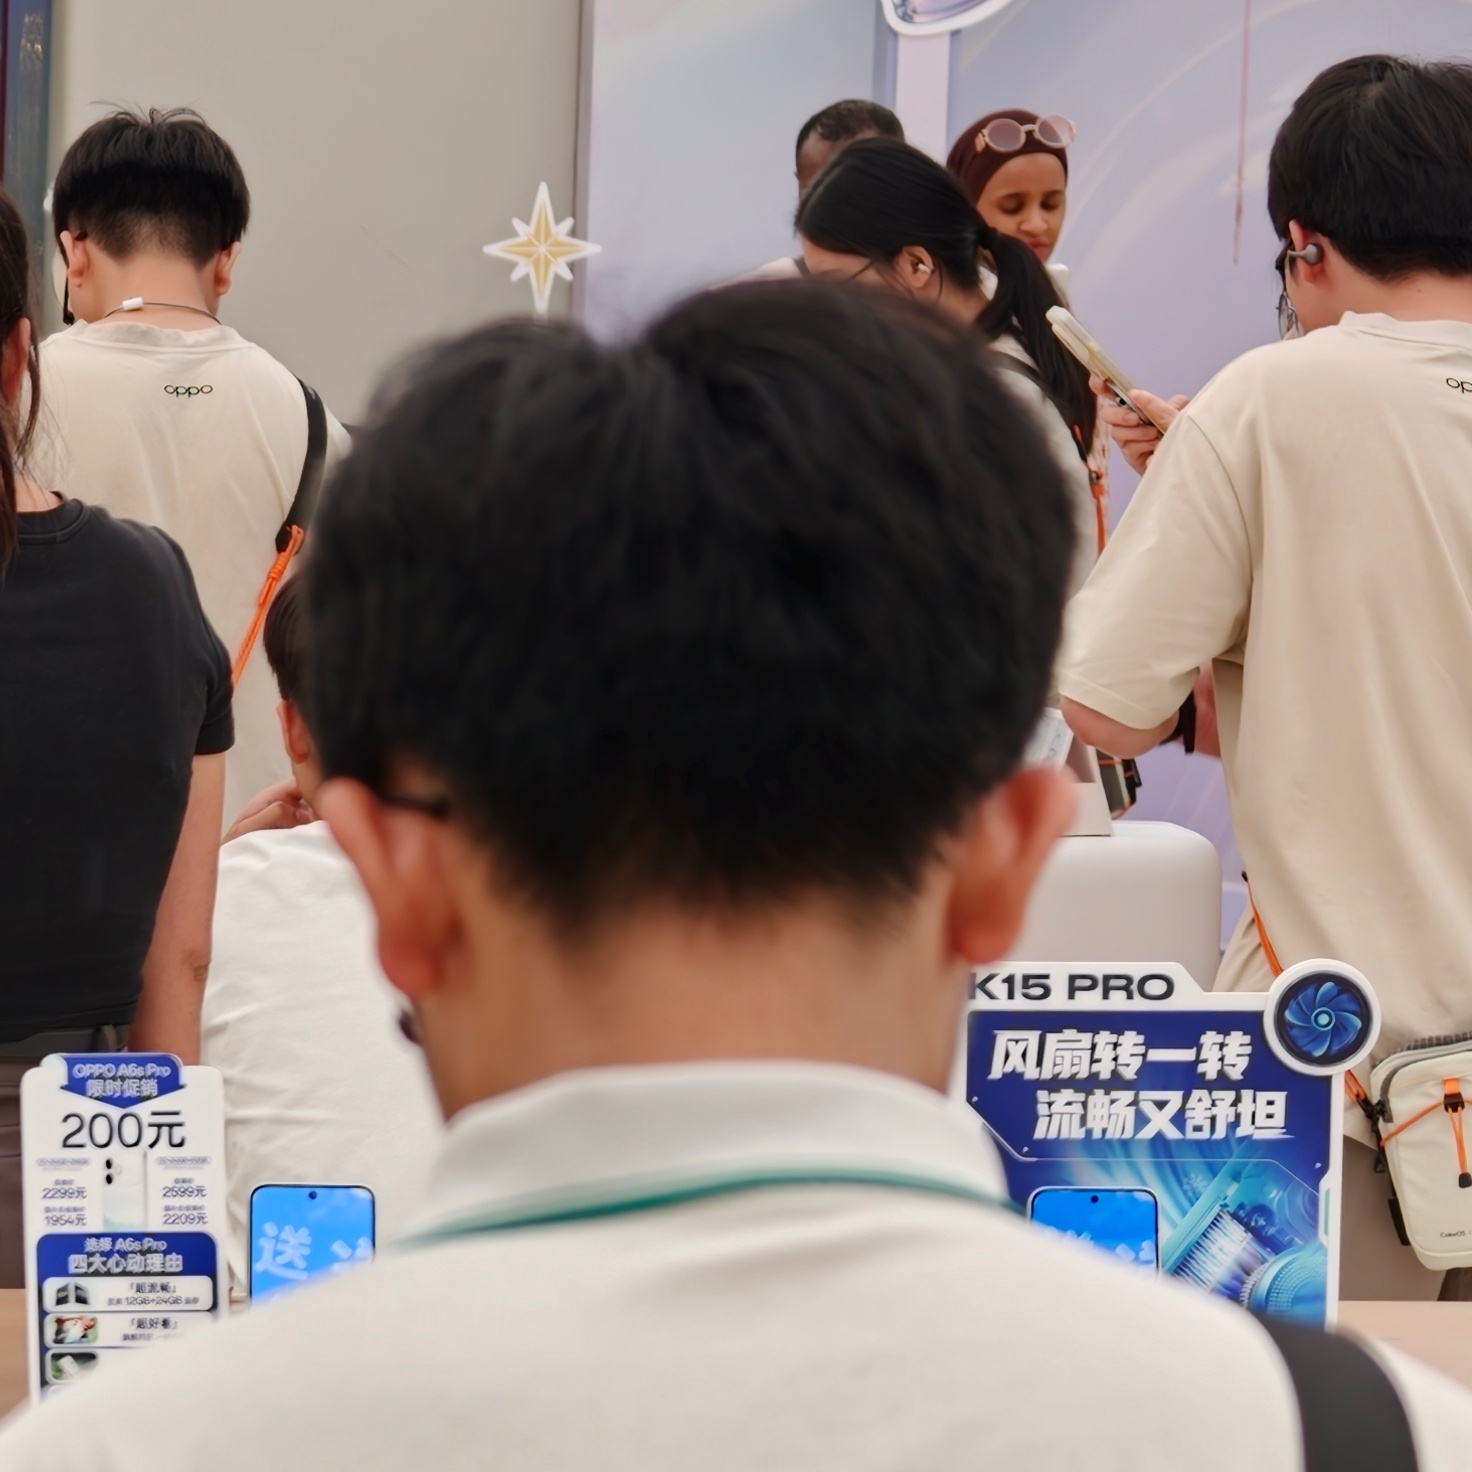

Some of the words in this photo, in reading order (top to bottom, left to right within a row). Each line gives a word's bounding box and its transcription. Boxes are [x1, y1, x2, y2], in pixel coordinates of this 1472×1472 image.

[164, 384, 214, 398] oppo
[970, 973, 1051, 1001] K15
[1067, 973, 1175, 1001] PRO
[987, 1029, 1253, 1081] 风扇转一转
[72, 1063, 115, 1078] OPPO
[146, 1062, 171, 1077] Pro
[1033, 1089, 1295, 1141] 流畅又舒坦
[61, 1111, 186, 1149] 200元
[42, 1187, 87, 1199] 2299元
[143, 1238, 167, 1252] Pro
[255, 1221, 312, 1280] 送
[69, 1254, 183, 1273] 四大心动理由
